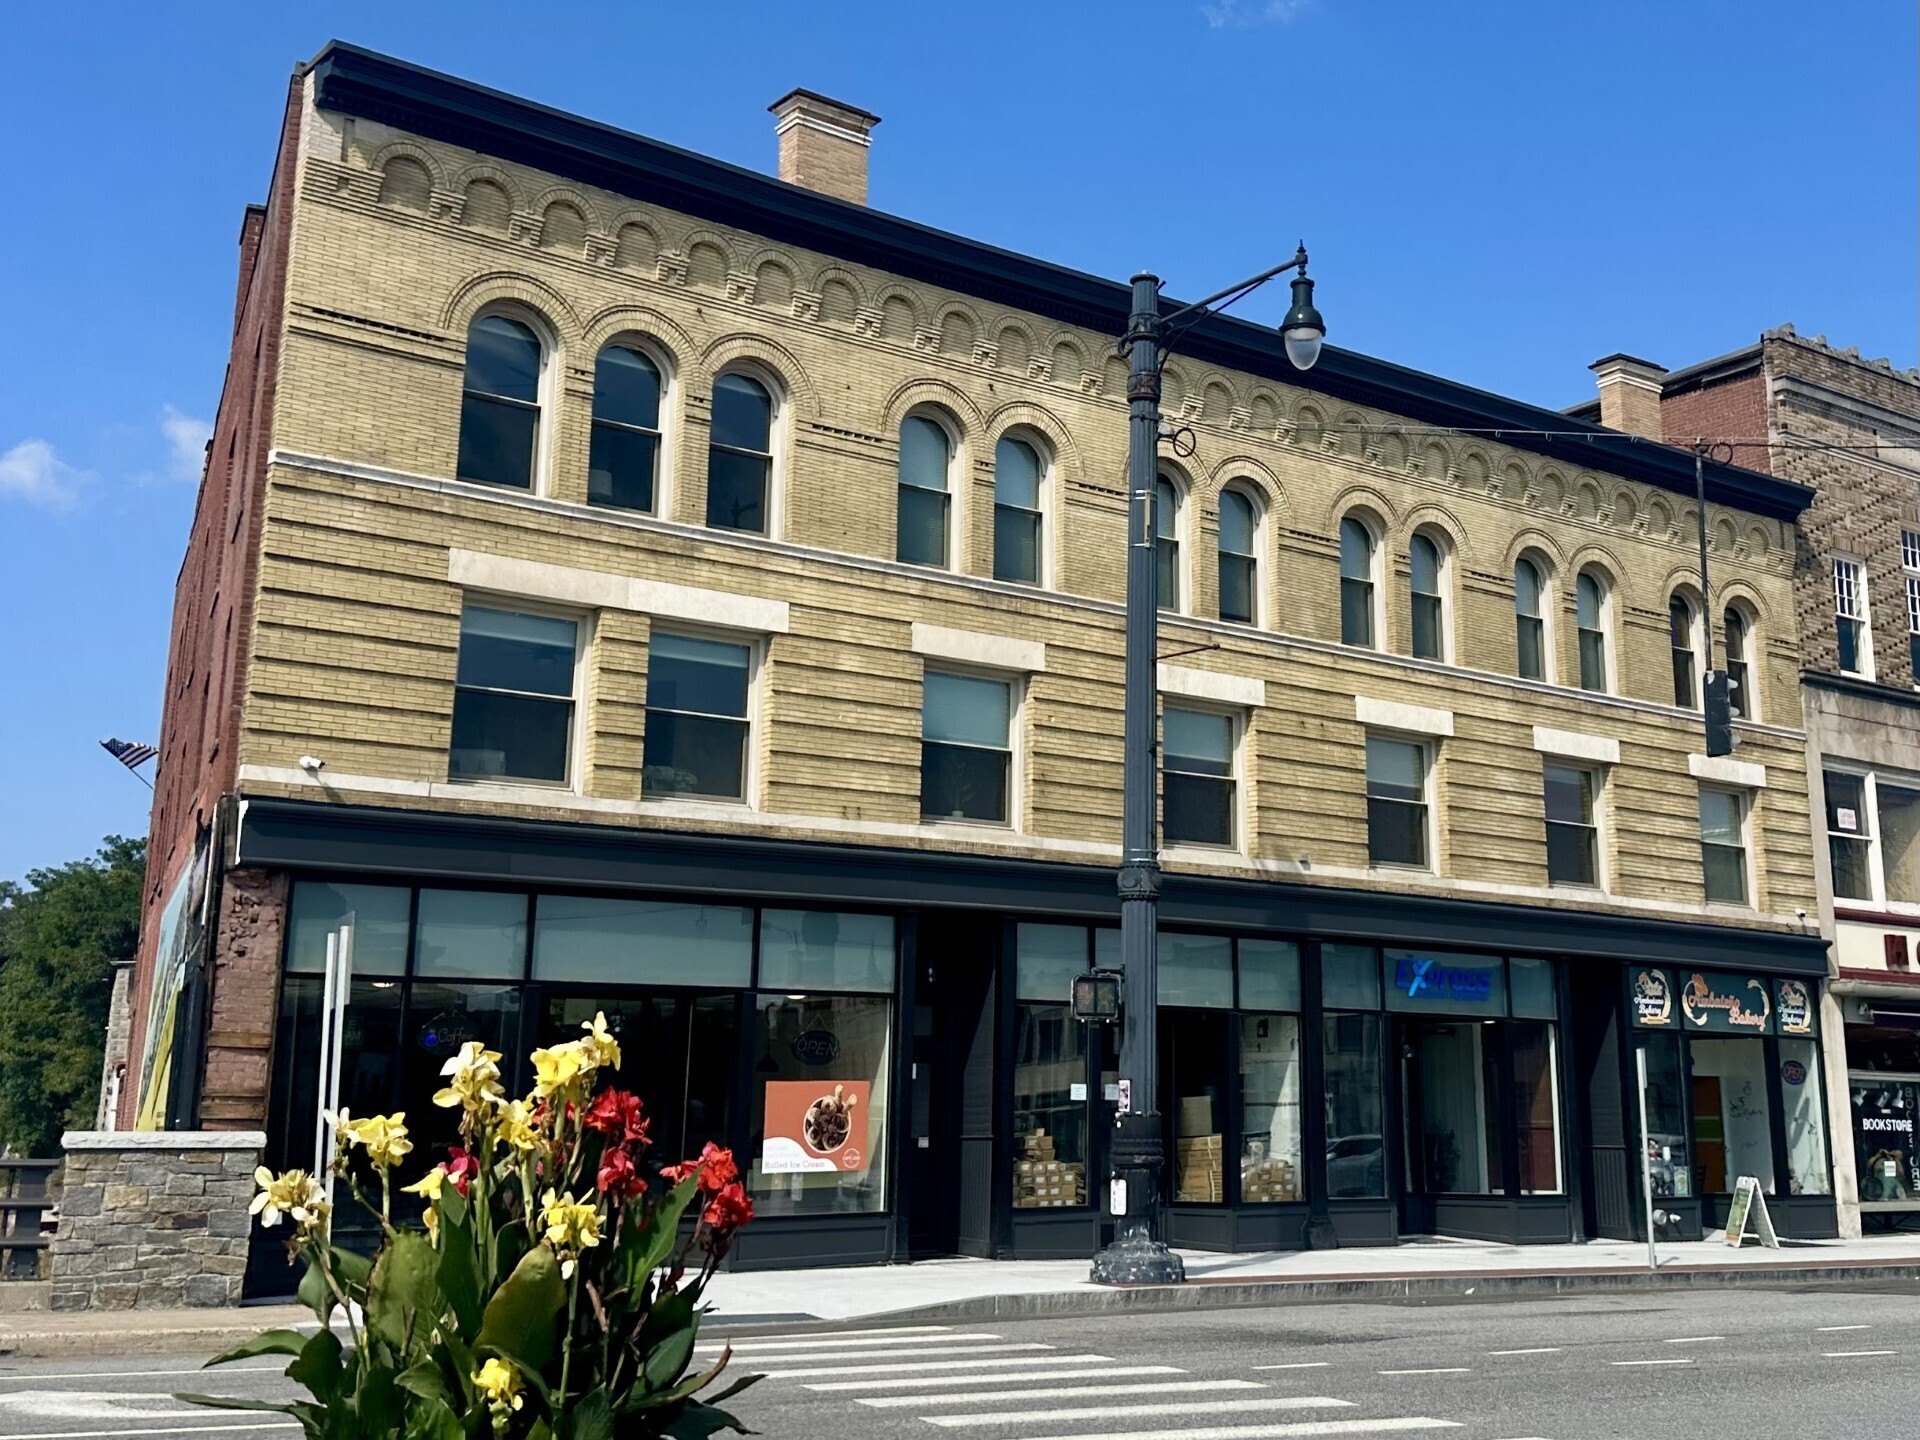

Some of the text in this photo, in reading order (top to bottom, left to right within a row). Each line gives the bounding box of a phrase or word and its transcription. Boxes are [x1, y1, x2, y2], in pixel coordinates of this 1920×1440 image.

[1728, 1006, 1766, 1031] Bakery
[797, 1039, 838, 1057] OPEN
[1862, 1118, 1913, 1132] BOOKSTORE
